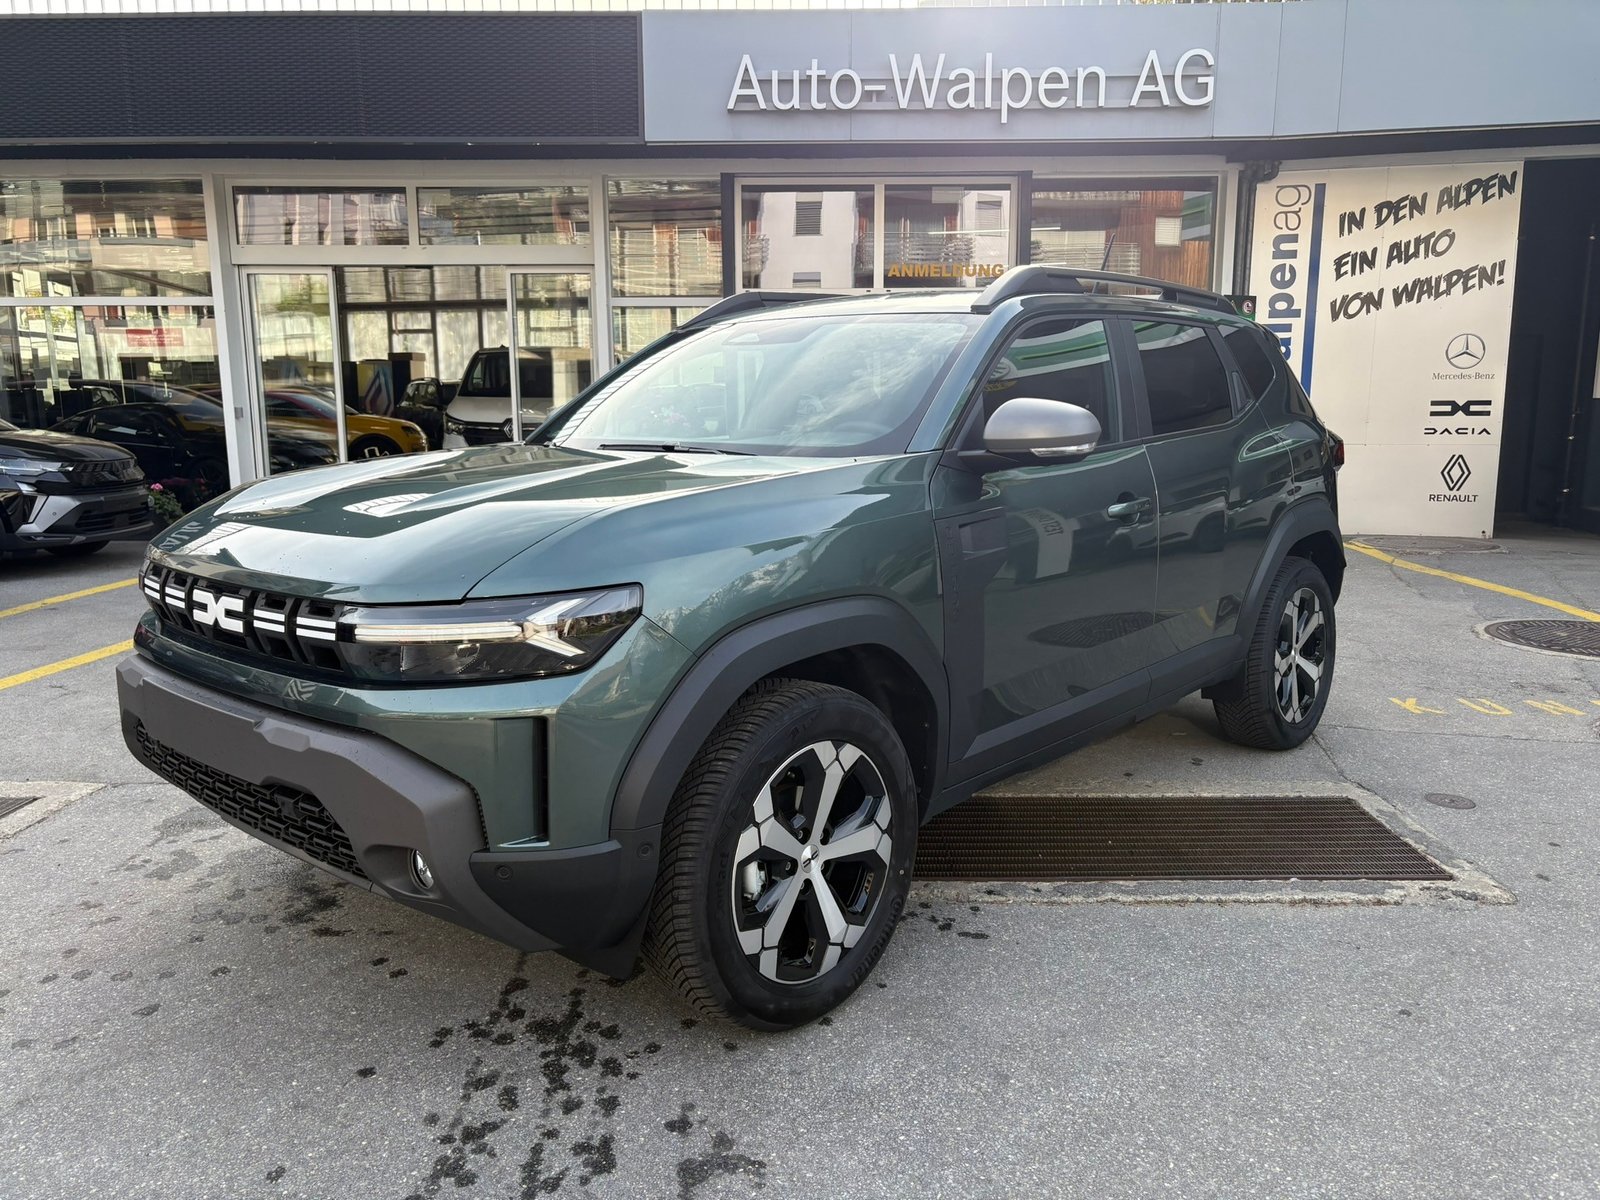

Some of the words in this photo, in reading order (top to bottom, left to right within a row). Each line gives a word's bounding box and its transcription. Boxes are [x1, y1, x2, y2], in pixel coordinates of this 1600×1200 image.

[726, 52, 1106, 124] Auto-Walpen
[1130, 48, 1216, 108] AG
[1338, 206, 1366, 238] IN
[1374, 191, 1429, 230] DEN
[1435, 170, 1518, 215] ALPEN
[1333, 246, 1378, 282] EIN
[1385, 228, 1456, 270] AUTO
[888, 263, 1005, 279] ANMELDUNG
[1329, 287, 1384, 323] VON
[1391, 259, 1506, 309] WALPEN!
[1431, 371, 1496, 381] Mercedes-Benz
[1423, 427, 1492, 435] DACIA
[1428, 493, 1479, 503] RENAULT
[1388, 697, 1600, 717] KUN
